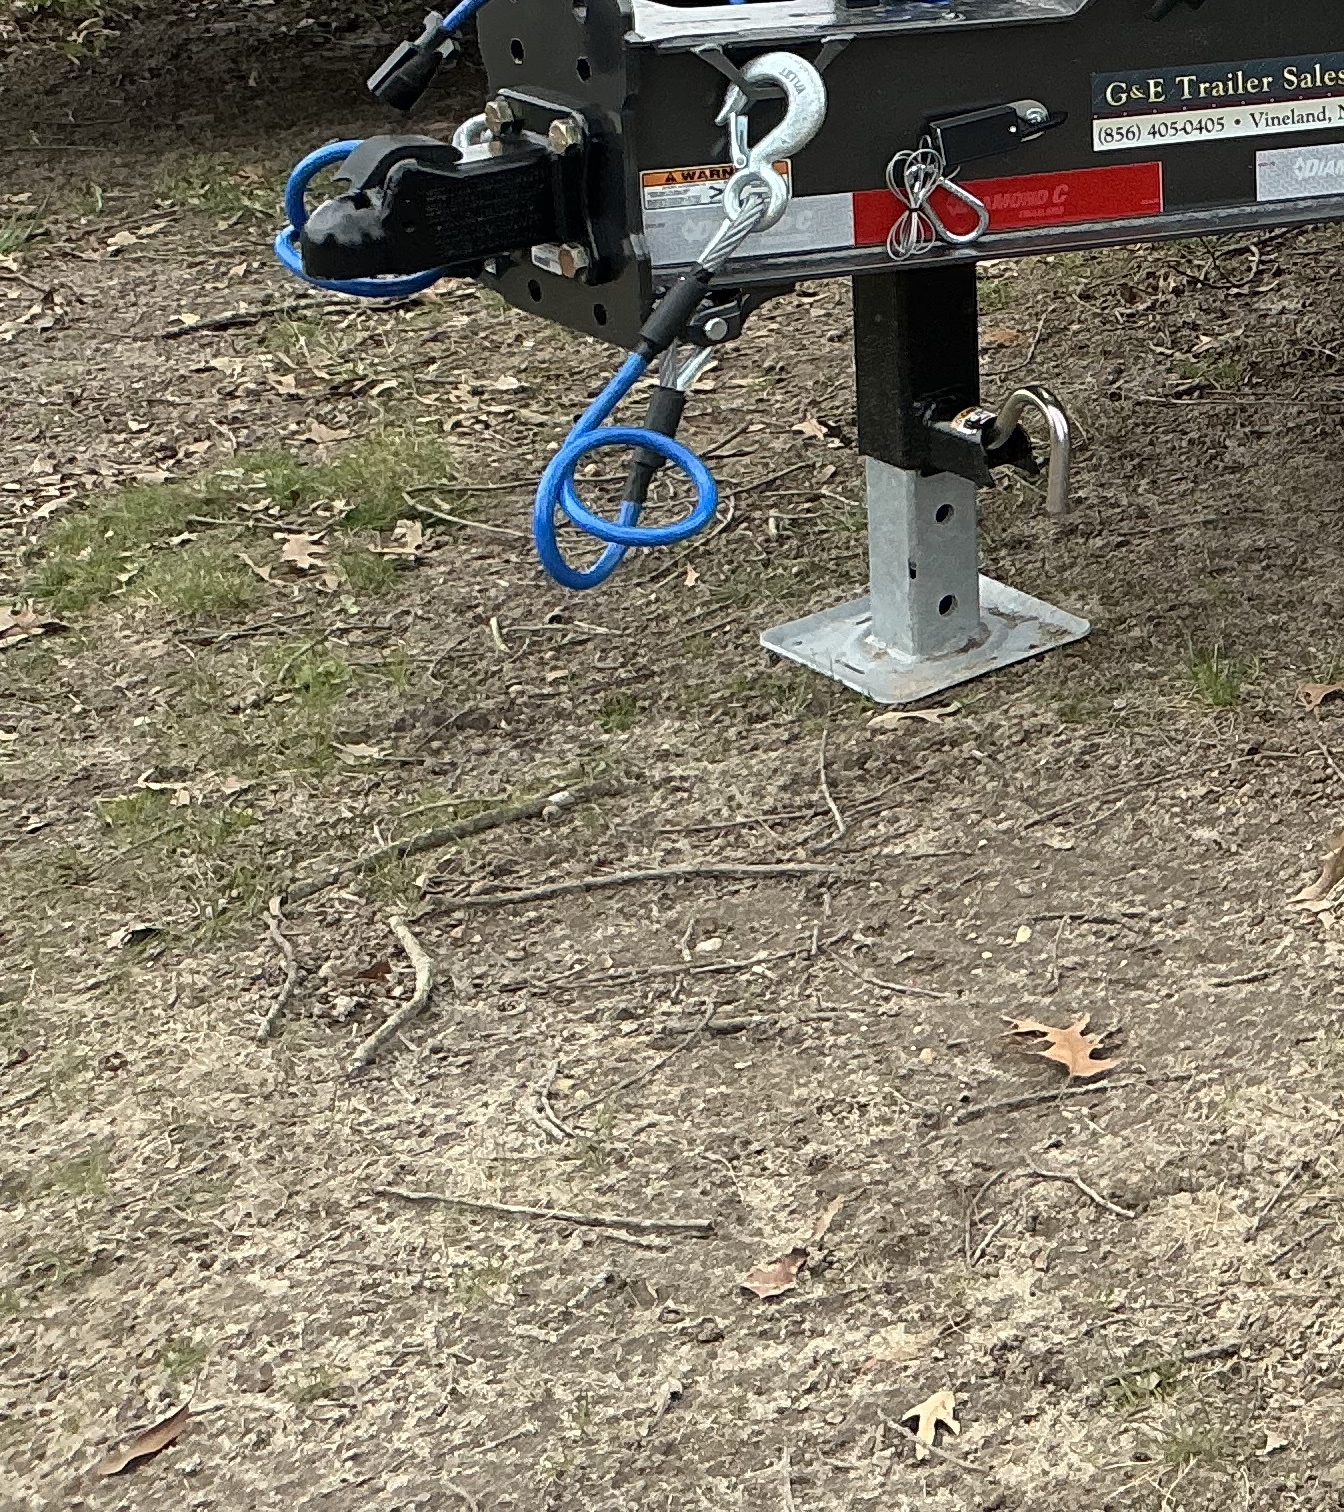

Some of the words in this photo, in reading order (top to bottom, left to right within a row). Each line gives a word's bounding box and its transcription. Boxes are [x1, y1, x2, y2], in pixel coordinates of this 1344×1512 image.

[1105, 78, 1166, 106] G&E
[1175, 70, 1274, 100] Trailer
[1097, 121, 1142, 146] (856)
[1147, 116, 1226, 140] 405-0405
[1249, 103, 1332, 130] Vineland,
[681, 167, 735, 183] WARN
[982, 190, 1048, 210] AMOND
[1052, 183, 1070, 204] C
